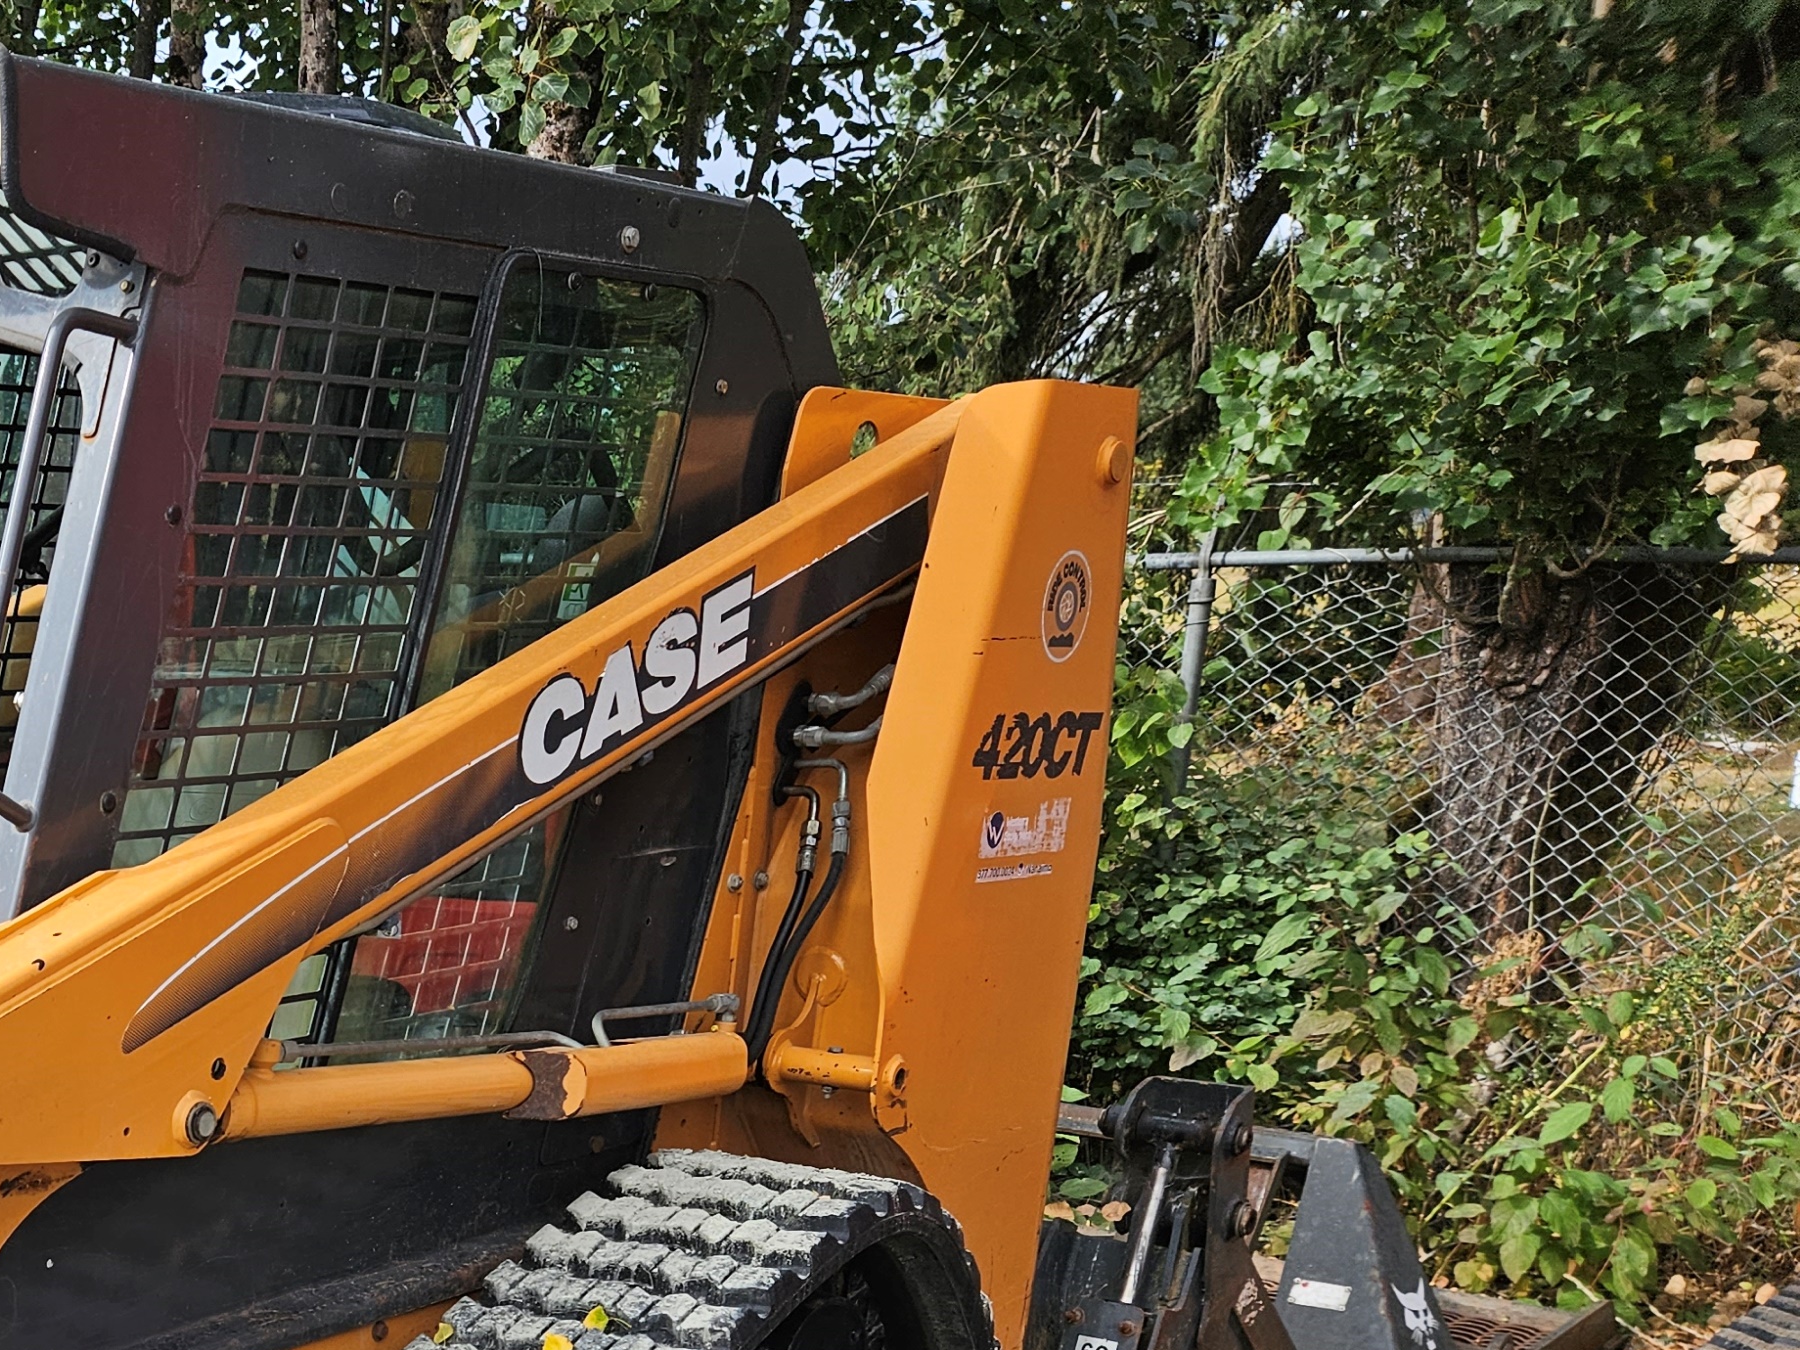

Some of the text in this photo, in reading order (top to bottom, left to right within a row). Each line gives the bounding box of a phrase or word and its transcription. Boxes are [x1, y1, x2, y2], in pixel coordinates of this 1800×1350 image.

[1047, 561, 1087, 612] RIDE CONTROL
[519, 569, 755, 785] CASE
[972, 711, 1104, 780] 420CT
